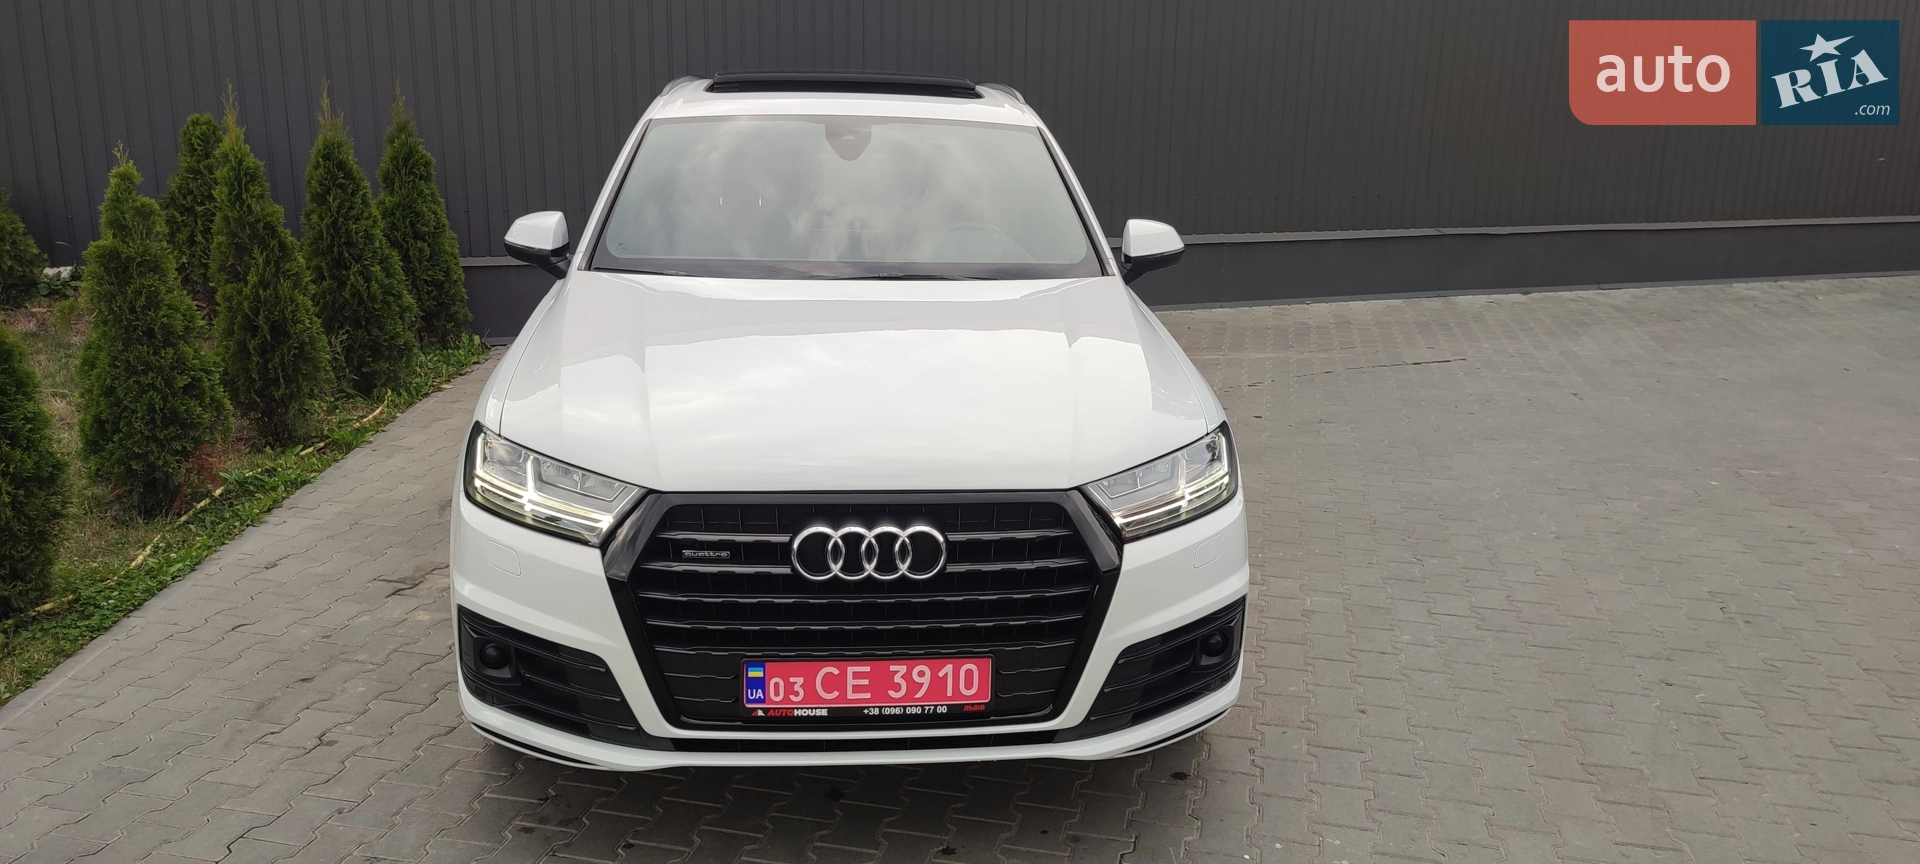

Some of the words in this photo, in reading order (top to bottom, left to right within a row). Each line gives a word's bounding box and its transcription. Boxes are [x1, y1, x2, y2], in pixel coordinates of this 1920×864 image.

[769, 677, 805, 702] 03
[815, 666, 872, 699] CE
[887, 663, 979, 698] 3910
[747, 689, 764, 700] UA
[767, 708, 828, 716] AUTOHOUSE
[881, 706, 904, 715] (096)
[906, 706, 922, 714] 090
[924, 706, 935, 714] 77
[937, 705, 948, 713] 00
